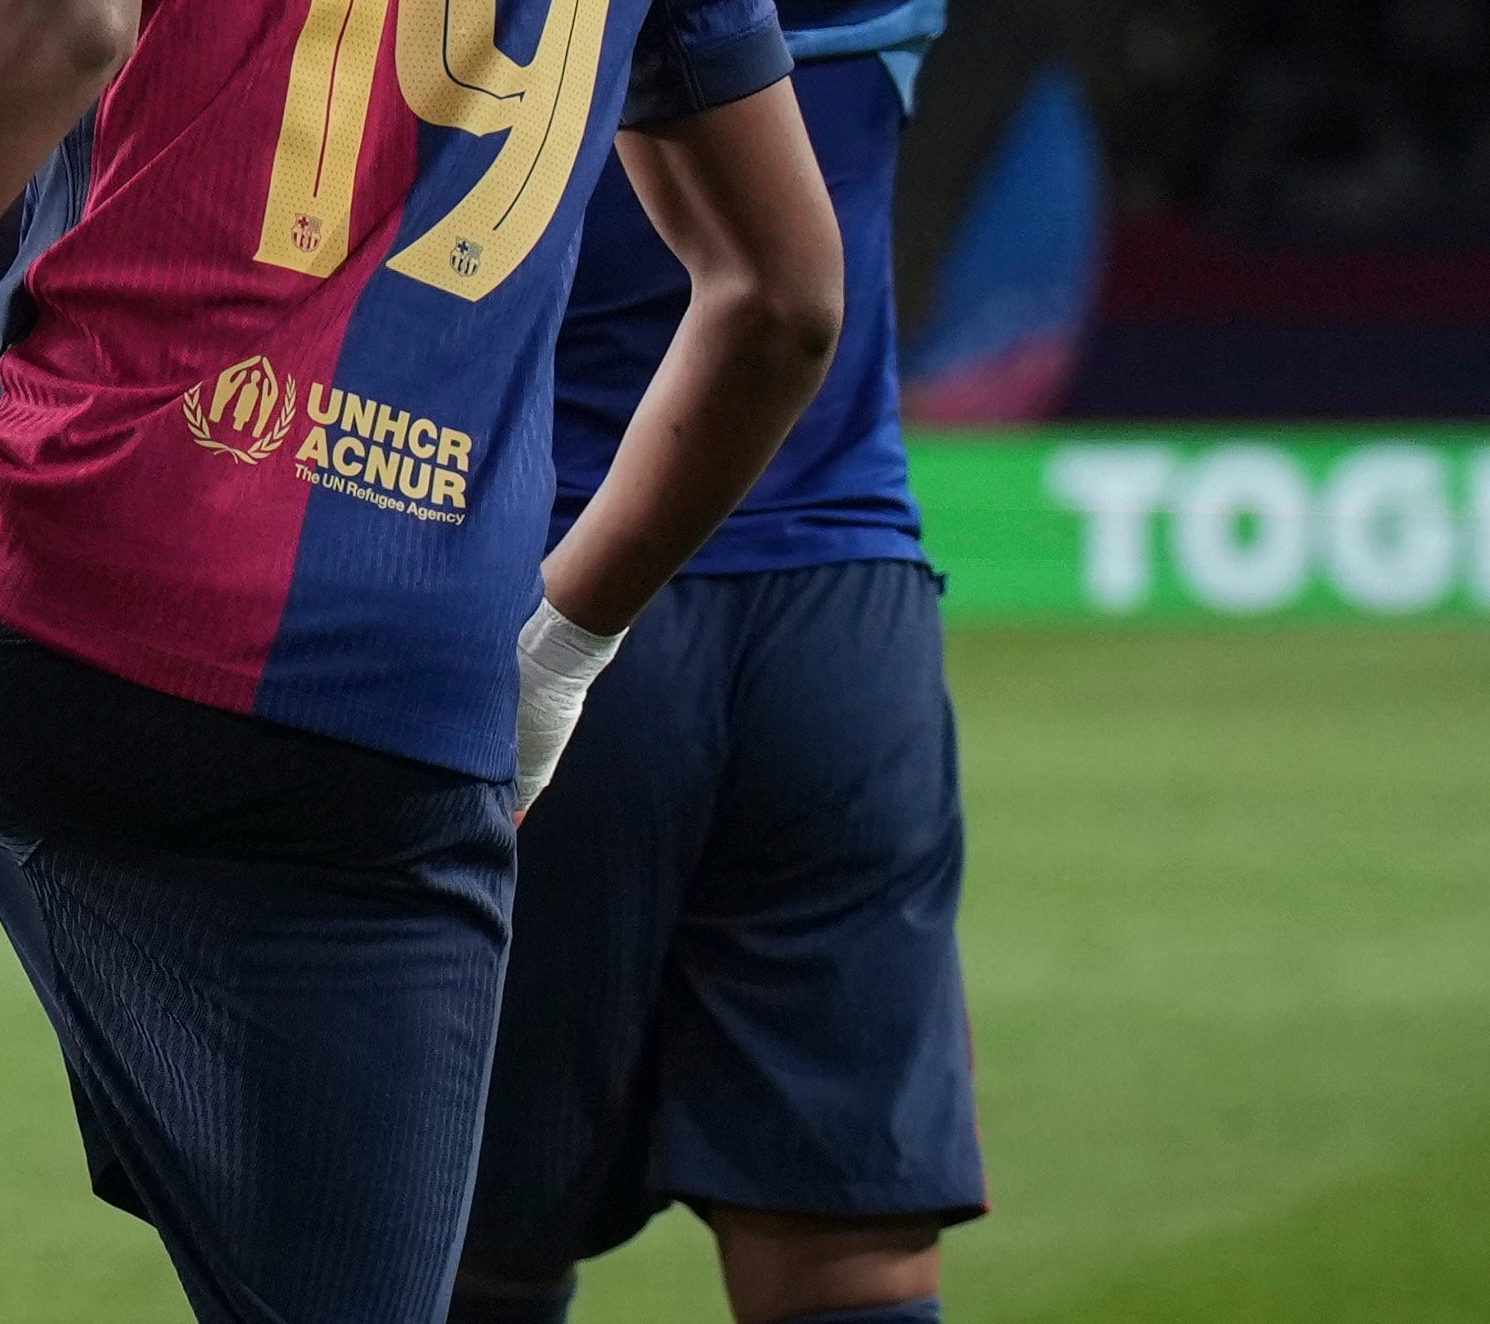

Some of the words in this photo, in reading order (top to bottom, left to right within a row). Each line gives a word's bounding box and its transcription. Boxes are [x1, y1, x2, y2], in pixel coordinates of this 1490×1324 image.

[294, 425, 467, 509] ACNUR
[307, 382, 473, 472] UNHCR
[294, 463, 320, 485] The
[322, 473, 345, 493] UN
[346, 479, 405, 513] Refugee
[406, 501, 466, 526] Agency
